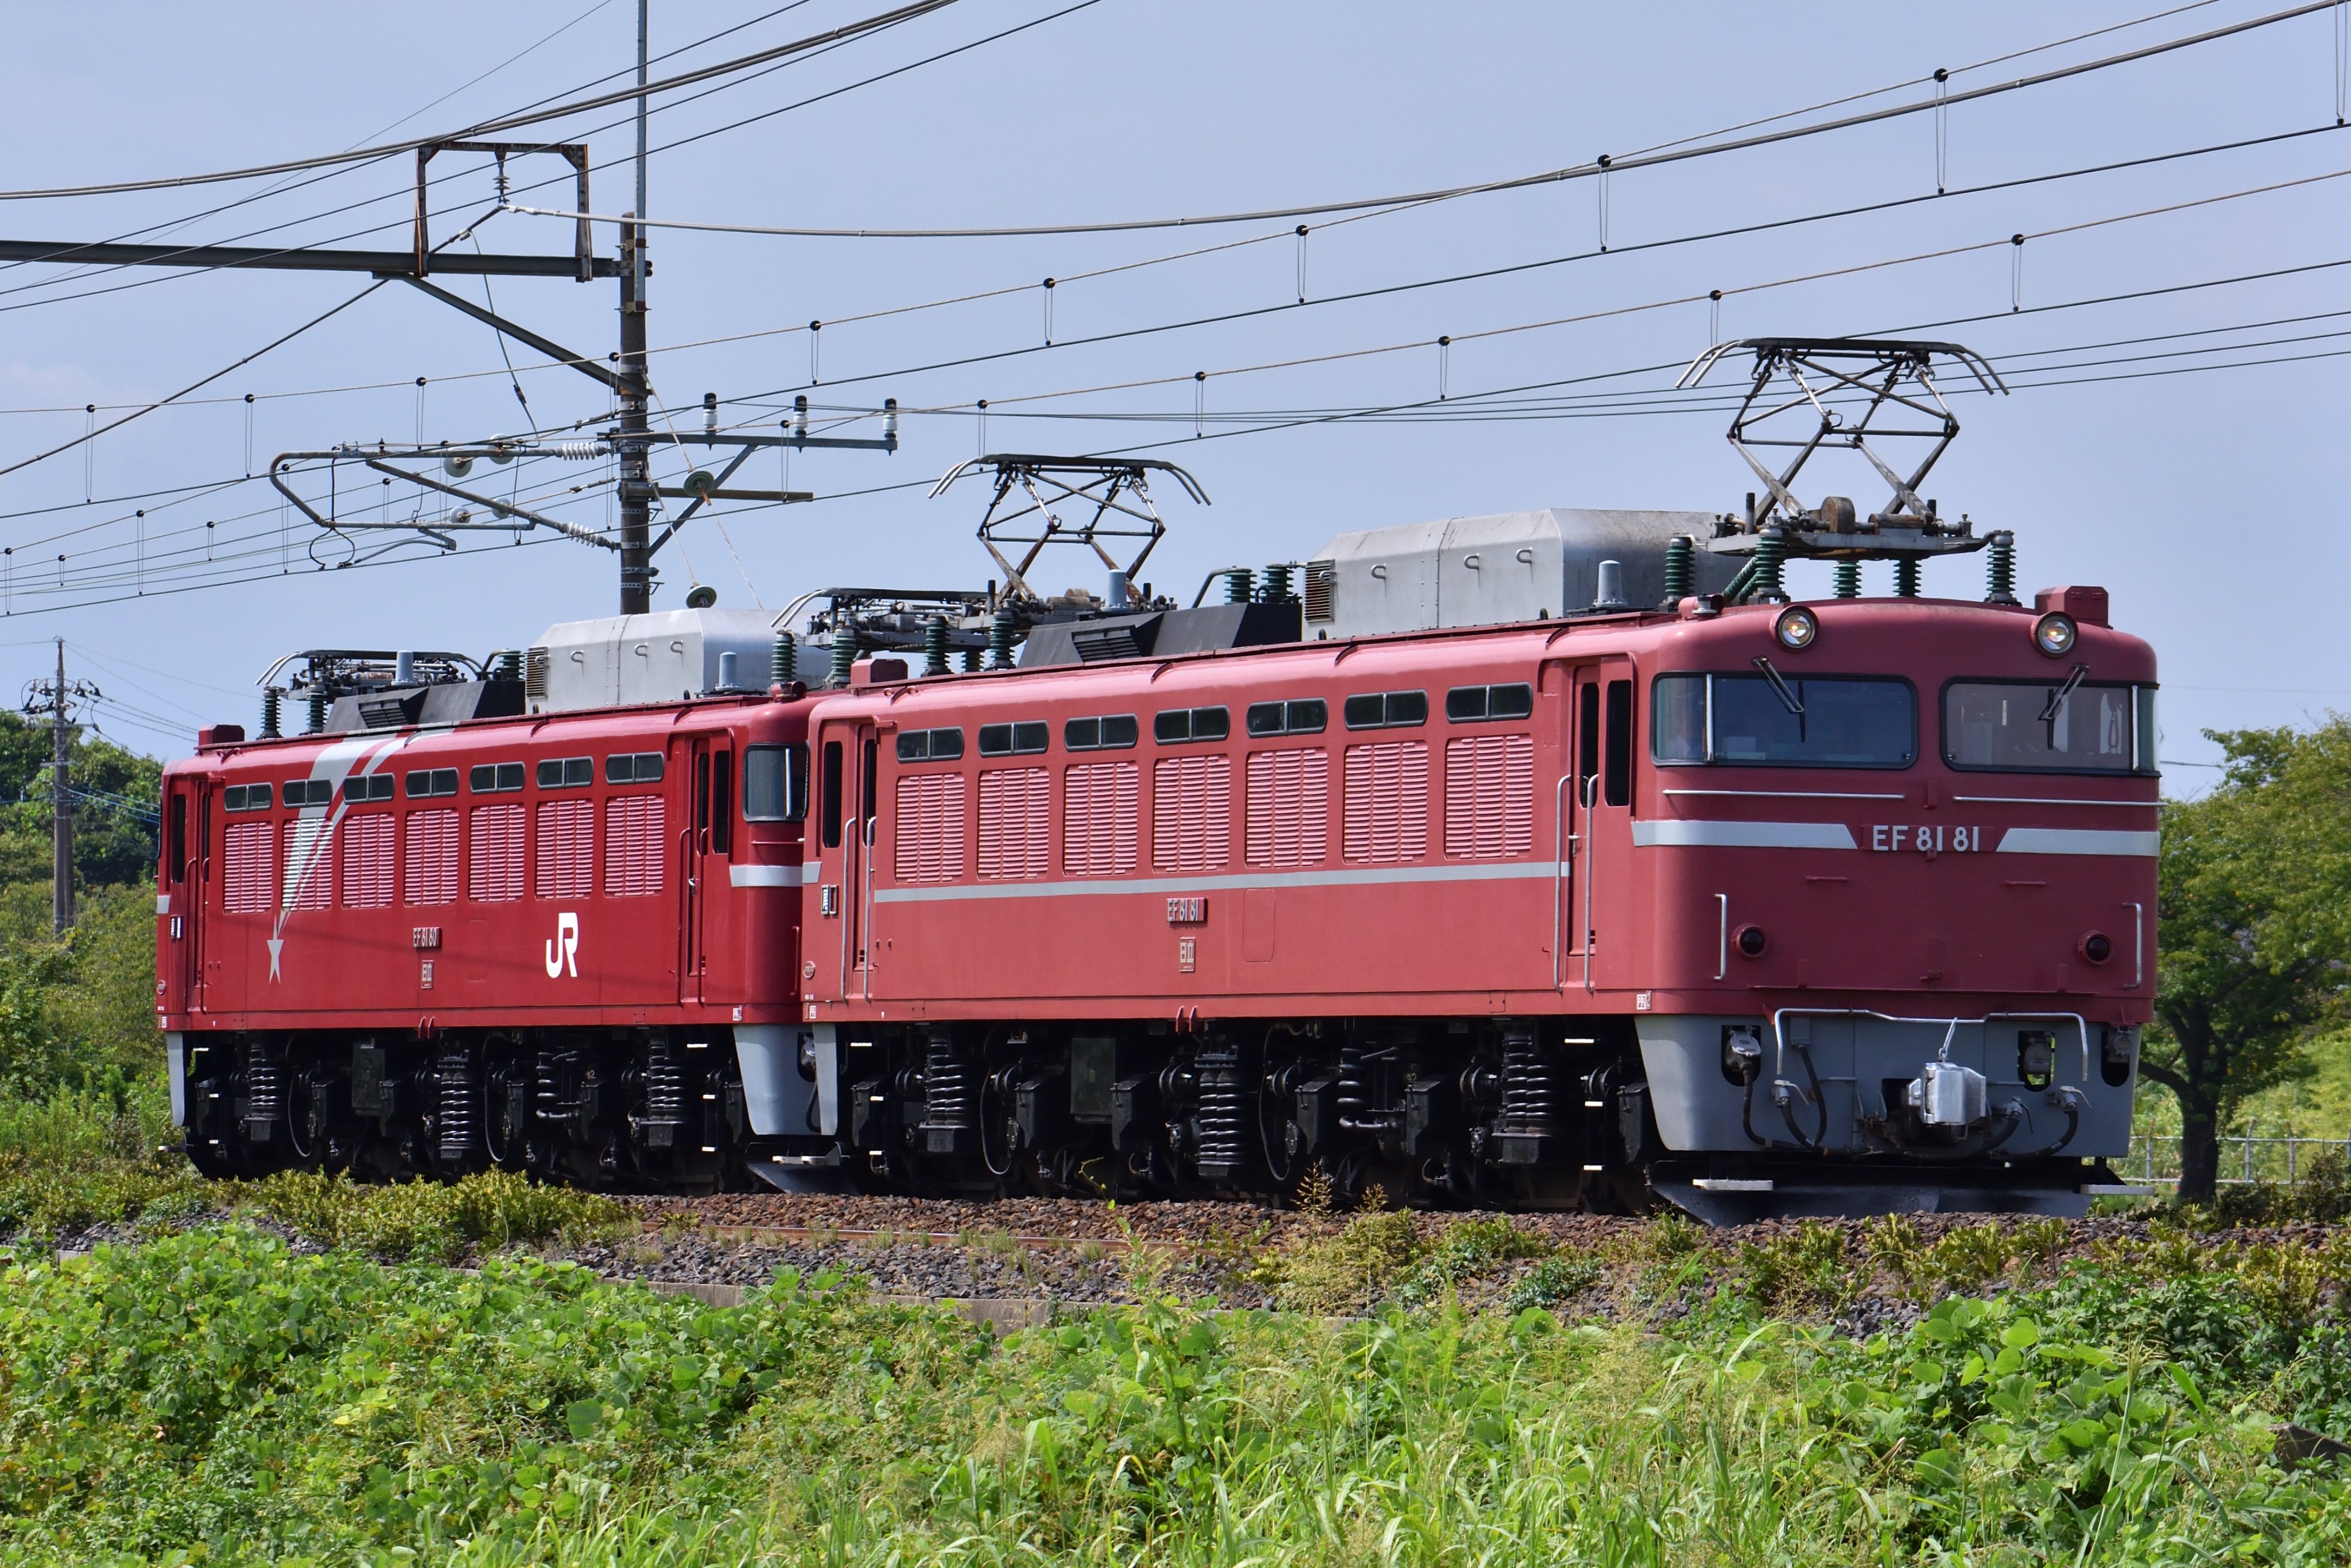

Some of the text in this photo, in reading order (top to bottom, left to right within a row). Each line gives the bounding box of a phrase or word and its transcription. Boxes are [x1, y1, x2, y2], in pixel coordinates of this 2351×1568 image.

[1873, 825, 1979, 852] EF 81 81
[1167, 899, 1198, 921] EF 81 81
[413, 928, 437, 948] EF 81 80
[546, 912, 579, 978] JR
[1180, 940, 1194, 963] 日立
[422, 962, 432, 981] 日立
